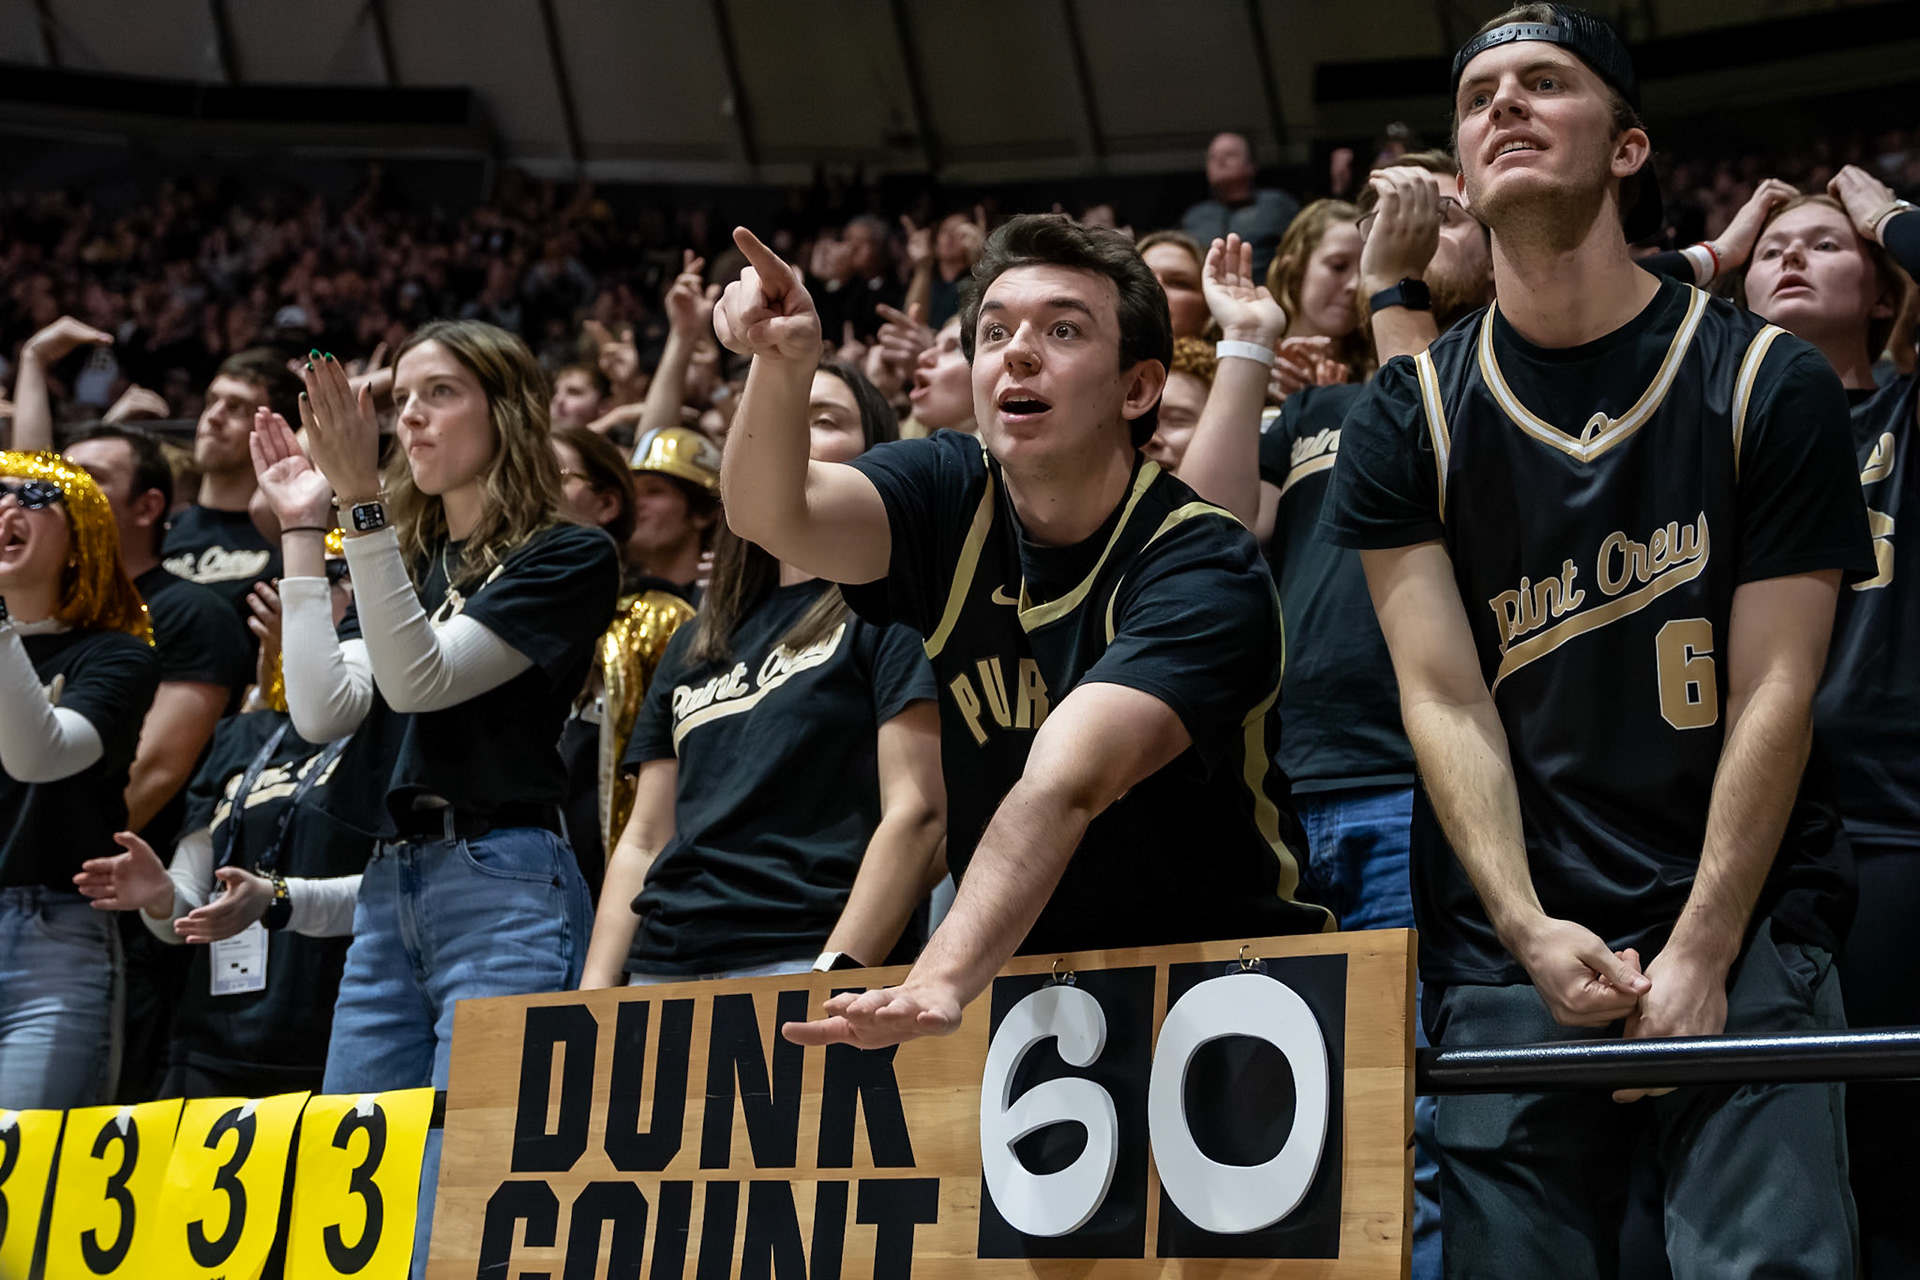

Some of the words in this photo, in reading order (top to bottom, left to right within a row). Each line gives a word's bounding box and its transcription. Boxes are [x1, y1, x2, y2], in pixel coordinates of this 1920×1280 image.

[1489, 559, 1586, 656] Pint
[1597, 511, 1710, 596] Crew
[949, 656, 1050, 746] PUR
[1656, 617, 1719, 731] 6
[510, 985, 917, 1173] DUNK
[80, 1114, 140, 1275] 3
[187, 1105, 257, 1269] 3
[323, 1102, 388, 1275] 3
